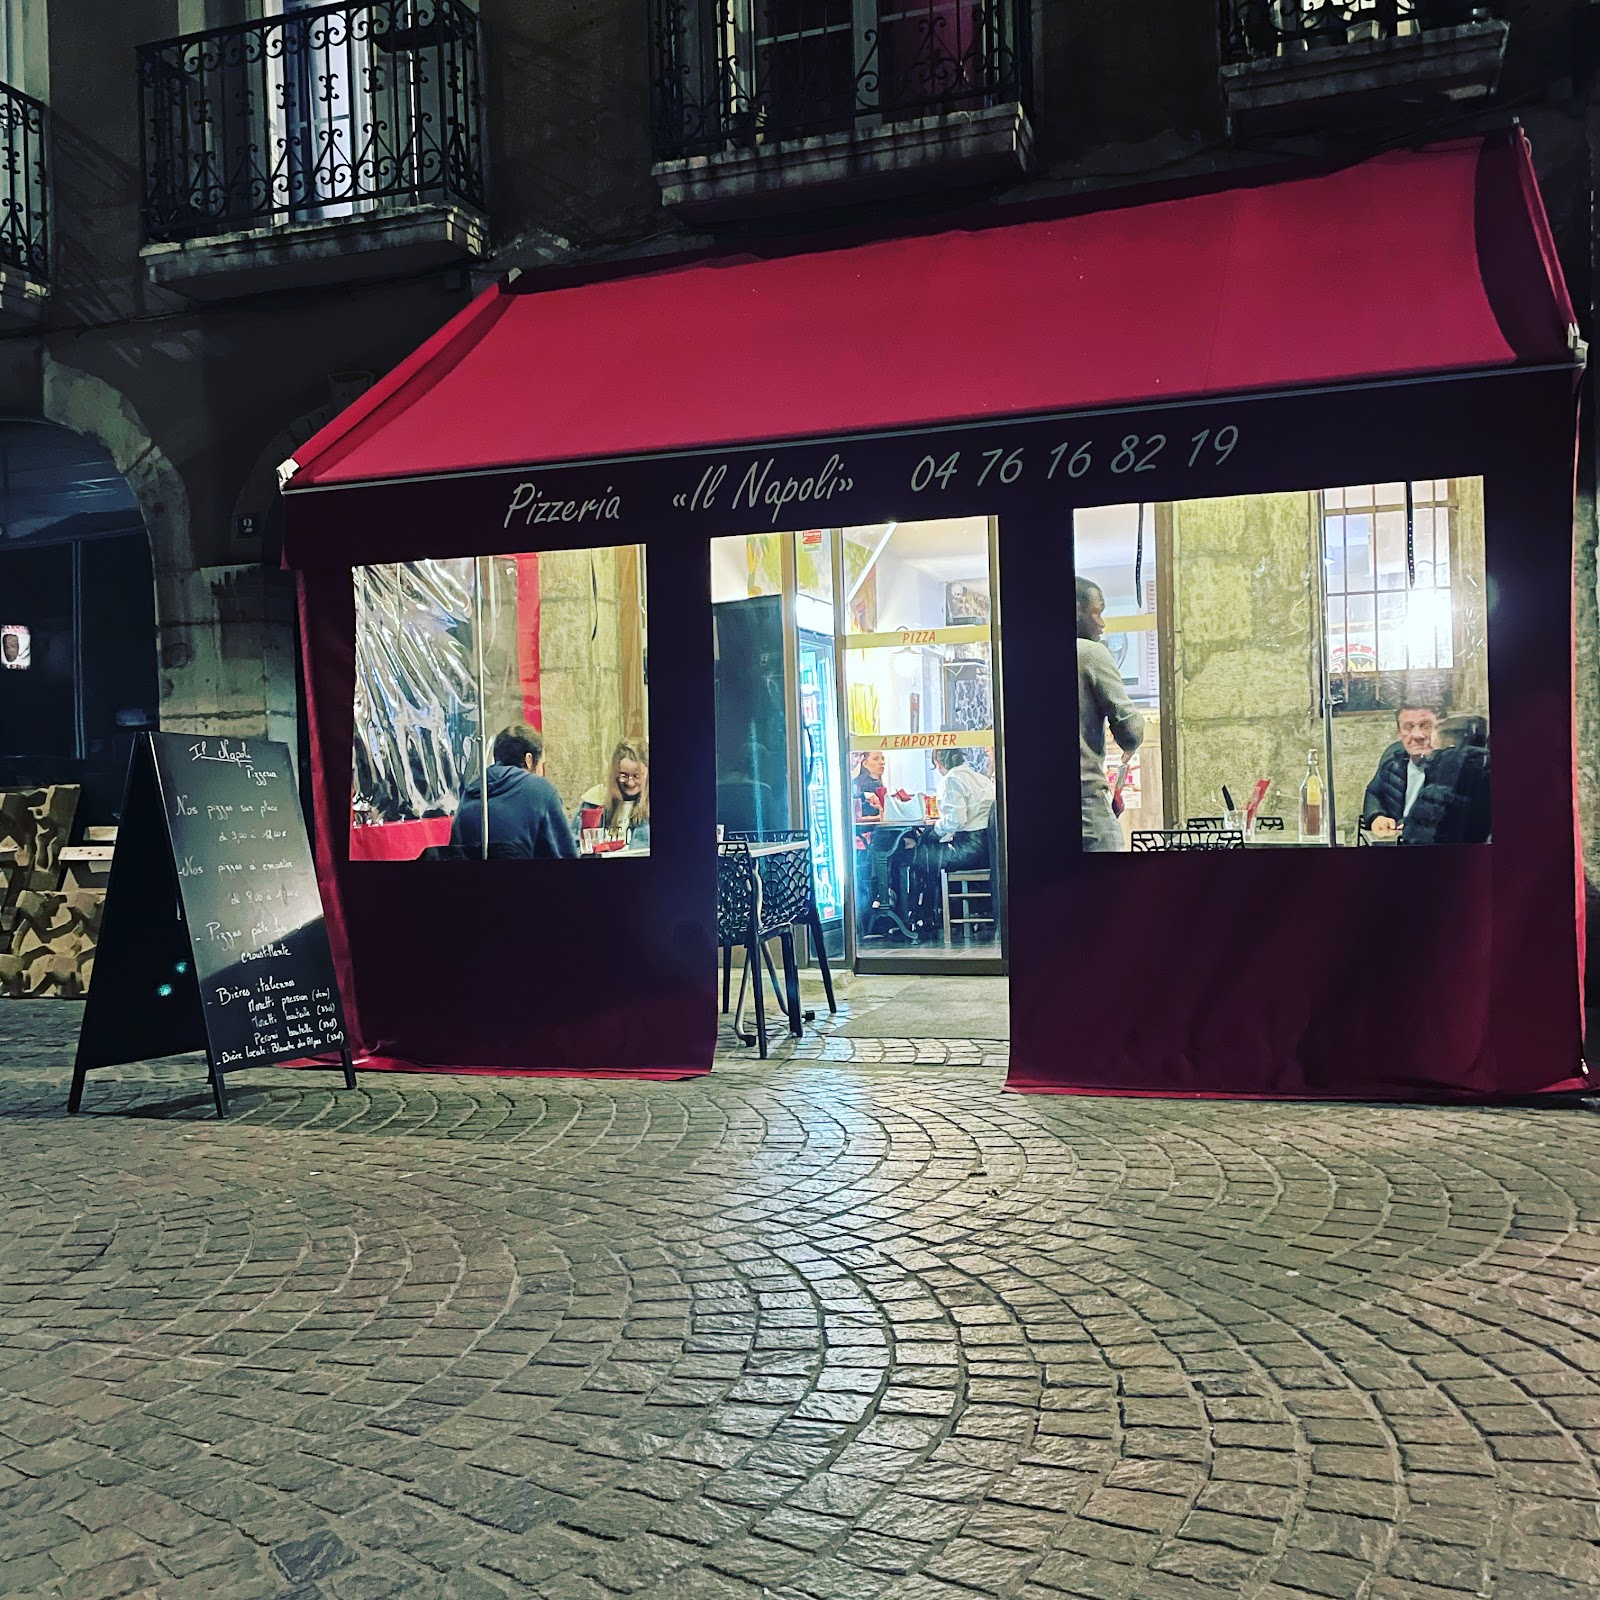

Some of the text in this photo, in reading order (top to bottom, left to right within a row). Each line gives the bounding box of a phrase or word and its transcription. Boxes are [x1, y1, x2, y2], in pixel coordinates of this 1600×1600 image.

[503, 481, 620, 529] Pizzeria
[910, 450, 961, 492] 04
[976, 447, 1024, 487] 76
[1047, 440, 1092, 479] 16
[1110, 434, 1167, 474] 82
[1191, 425, 1239, 468] 19
[902, 630, 936, 644] PIZZA
[189, 739, 252, 768] Il Napoli
[880, 734, 957, 749] A EMPORTER
[245, 764, 278, 786] Pizzeria
[175, 794, 278, 820] Nos pizzas sur place
[205, 921, 242, 952] Pizzas
[240, 942, 292, 964] croustillante
[215, 986, 251, 1006] Bières
[257, 975, 295, 992] italiennes
[248, 996, 275, 1013] Moretti
[281, 994, 308, 1012] pression
[286, 1023, 313, 1037] bouteille
[221, 1050, 243, 1064] Bière
[270, 1040, 295, 1054] Blanche
[306, 1036, 322, 1049] Alpes
